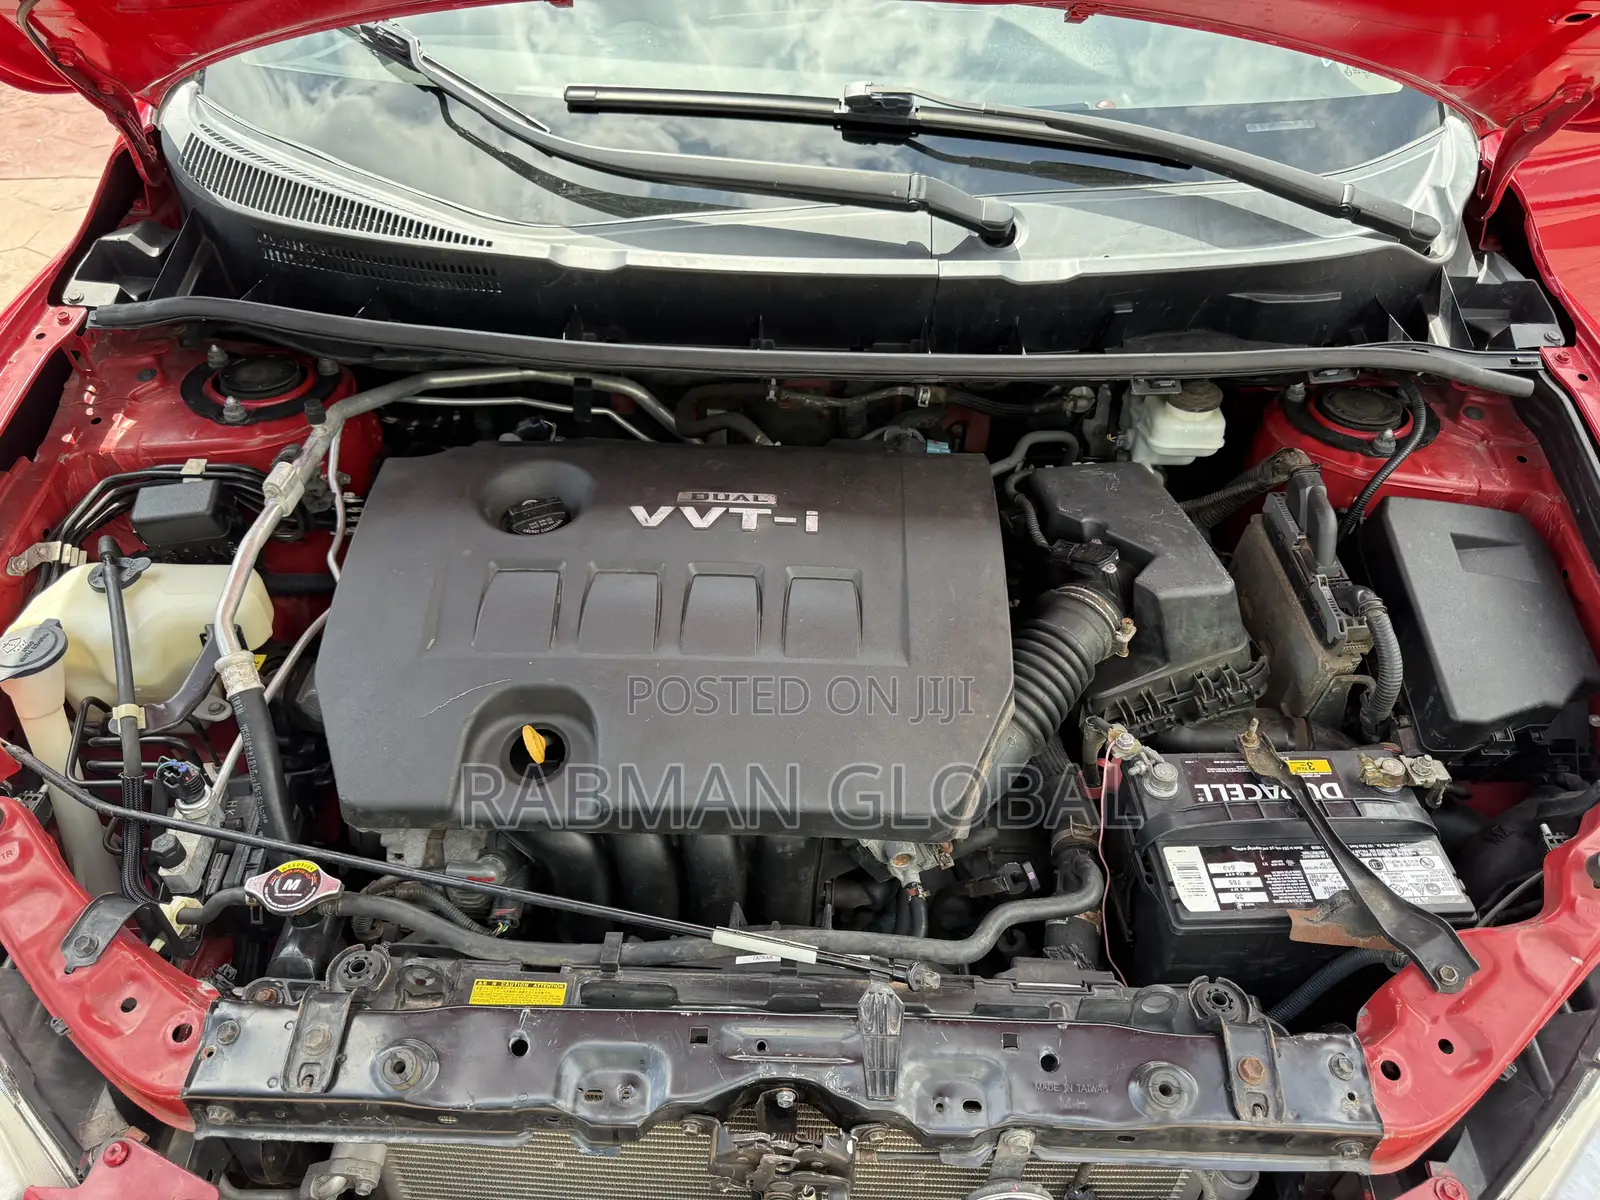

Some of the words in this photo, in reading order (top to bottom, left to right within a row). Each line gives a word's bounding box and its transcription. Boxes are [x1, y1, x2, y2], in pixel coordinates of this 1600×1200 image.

[691, 492, 769, 503] DUAL
[630, 505, 819, 533] VVT-i
[1306, 761, 1316, 771] 3
[282, 879, 302, 890] M
[1034, 1081, 1060, 1092] MADE
[1062, 1083, 1073, 1093] IN
[1076, 1083, 1109, 1093] TAIWAN
